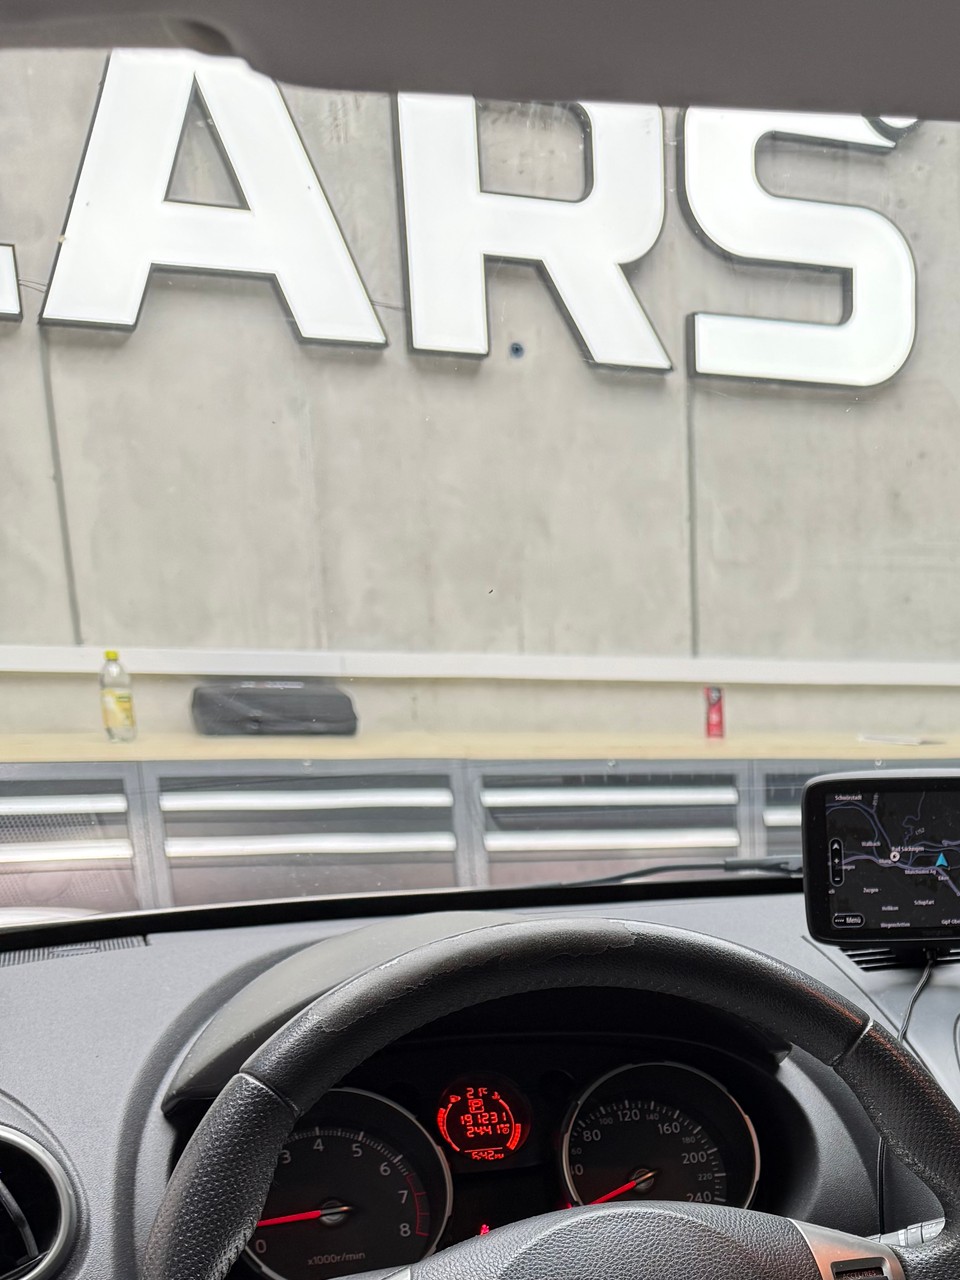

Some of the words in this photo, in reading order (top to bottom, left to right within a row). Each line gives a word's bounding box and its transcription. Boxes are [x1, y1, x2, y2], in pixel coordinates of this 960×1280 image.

[0, 46, 917, 387] ARS
[600, 1116, 614, 1125] 100
[618, 1109, 641, 1122] 120
[646, 1112, 660, 1121] 140
[583, 1129, 601, 1142] 80
[658, 1122, 681, 1135] 160
[313, 1138, 324, 1152] 4
[682, 1136, 696, 1145] 180
[281, 1150, 292, 1164] 3
[352, 1143, 363, 1157] 5
[682, 1151, 707, 1165] 200
[379, 1162, 391, 1176] 6
[698, 1173, 713, 1181] 220
[398, 1190, 408, 1204] 7
[687, 1191, 712, 1204] 240
[400, 1223, 411, 1237] 8
[255, 1240, 267, 1254] 0
